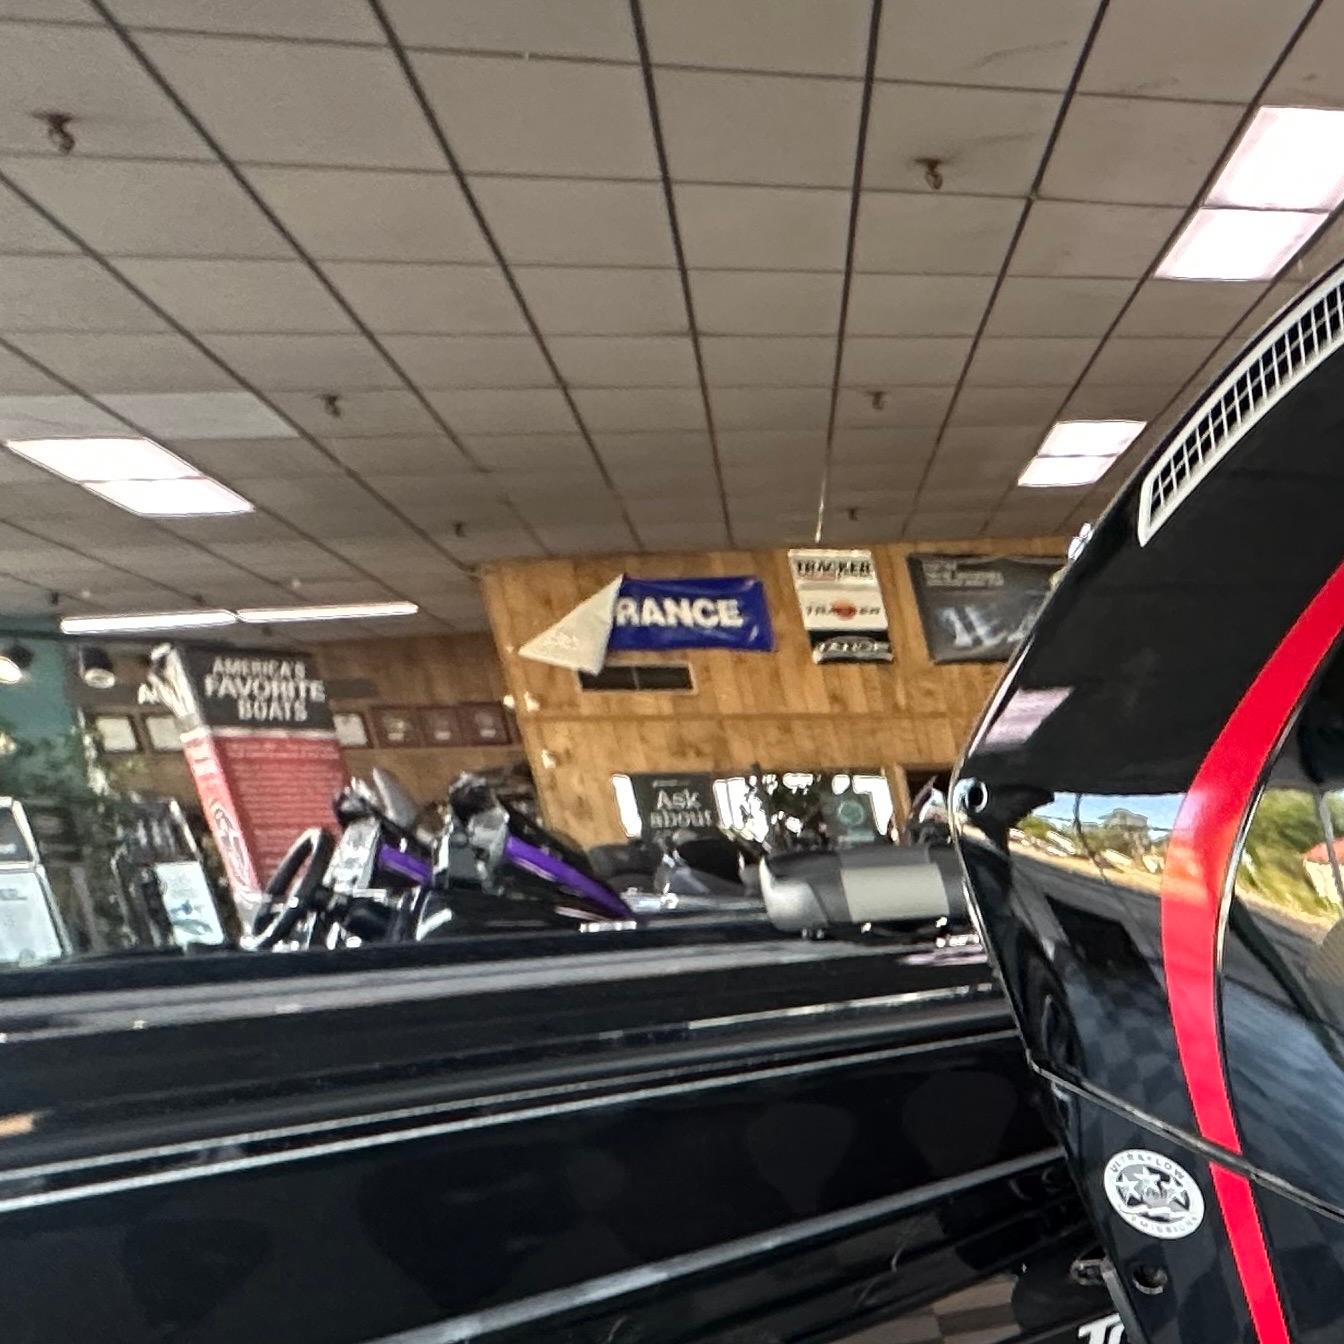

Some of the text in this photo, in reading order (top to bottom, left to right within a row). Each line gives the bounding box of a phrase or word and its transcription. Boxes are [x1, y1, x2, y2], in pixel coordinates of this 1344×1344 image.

[614, 596, 745, 629] RANCE
[204, 673, 326, 702] FAVORITE
[656, 789, 699, 811] Ask
[650, 809, 712, 829] about
